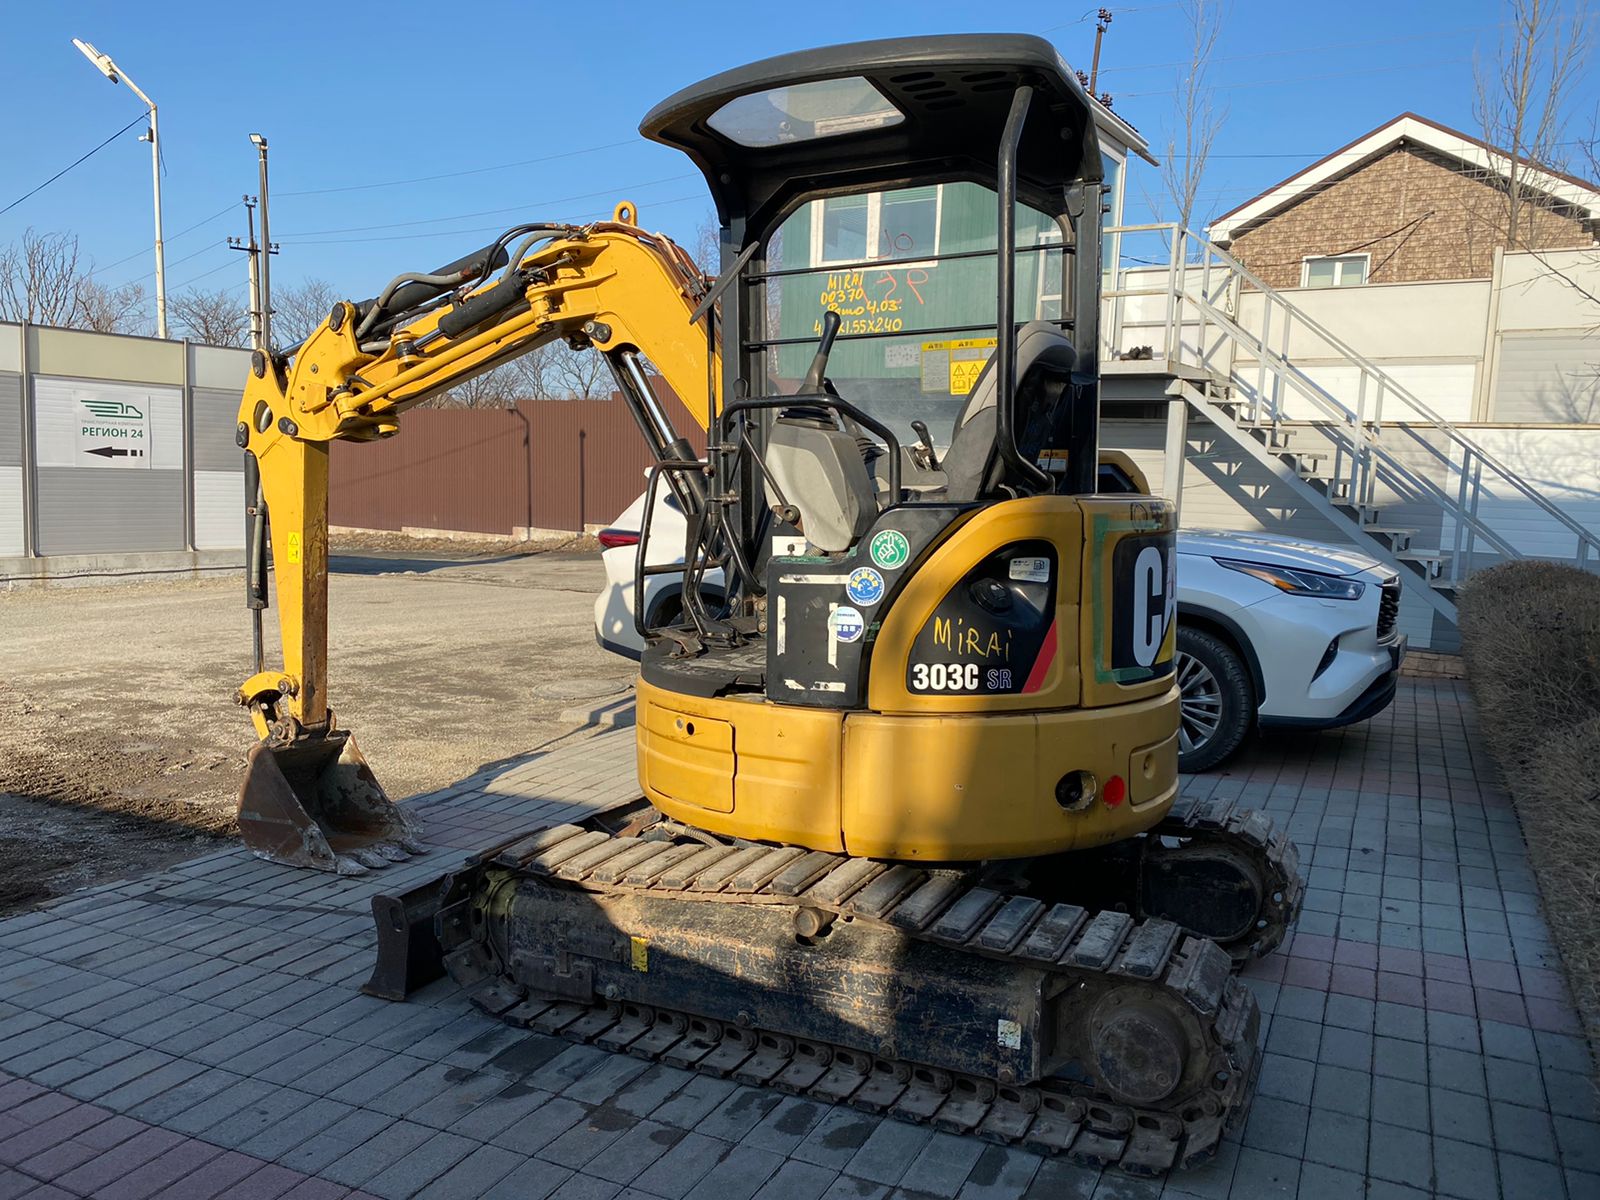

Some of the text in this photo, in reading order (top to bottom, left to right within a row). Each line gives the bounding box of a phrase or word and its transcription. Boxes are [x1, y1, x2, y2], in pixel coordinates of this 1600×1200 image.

[828, 271, 864, 292] MIRAI
[821, 288, 864, 305] 00370
[82, 427, 143, 438] РЕГИОН 24
[913, 663, 1012, 690] 303C SR
